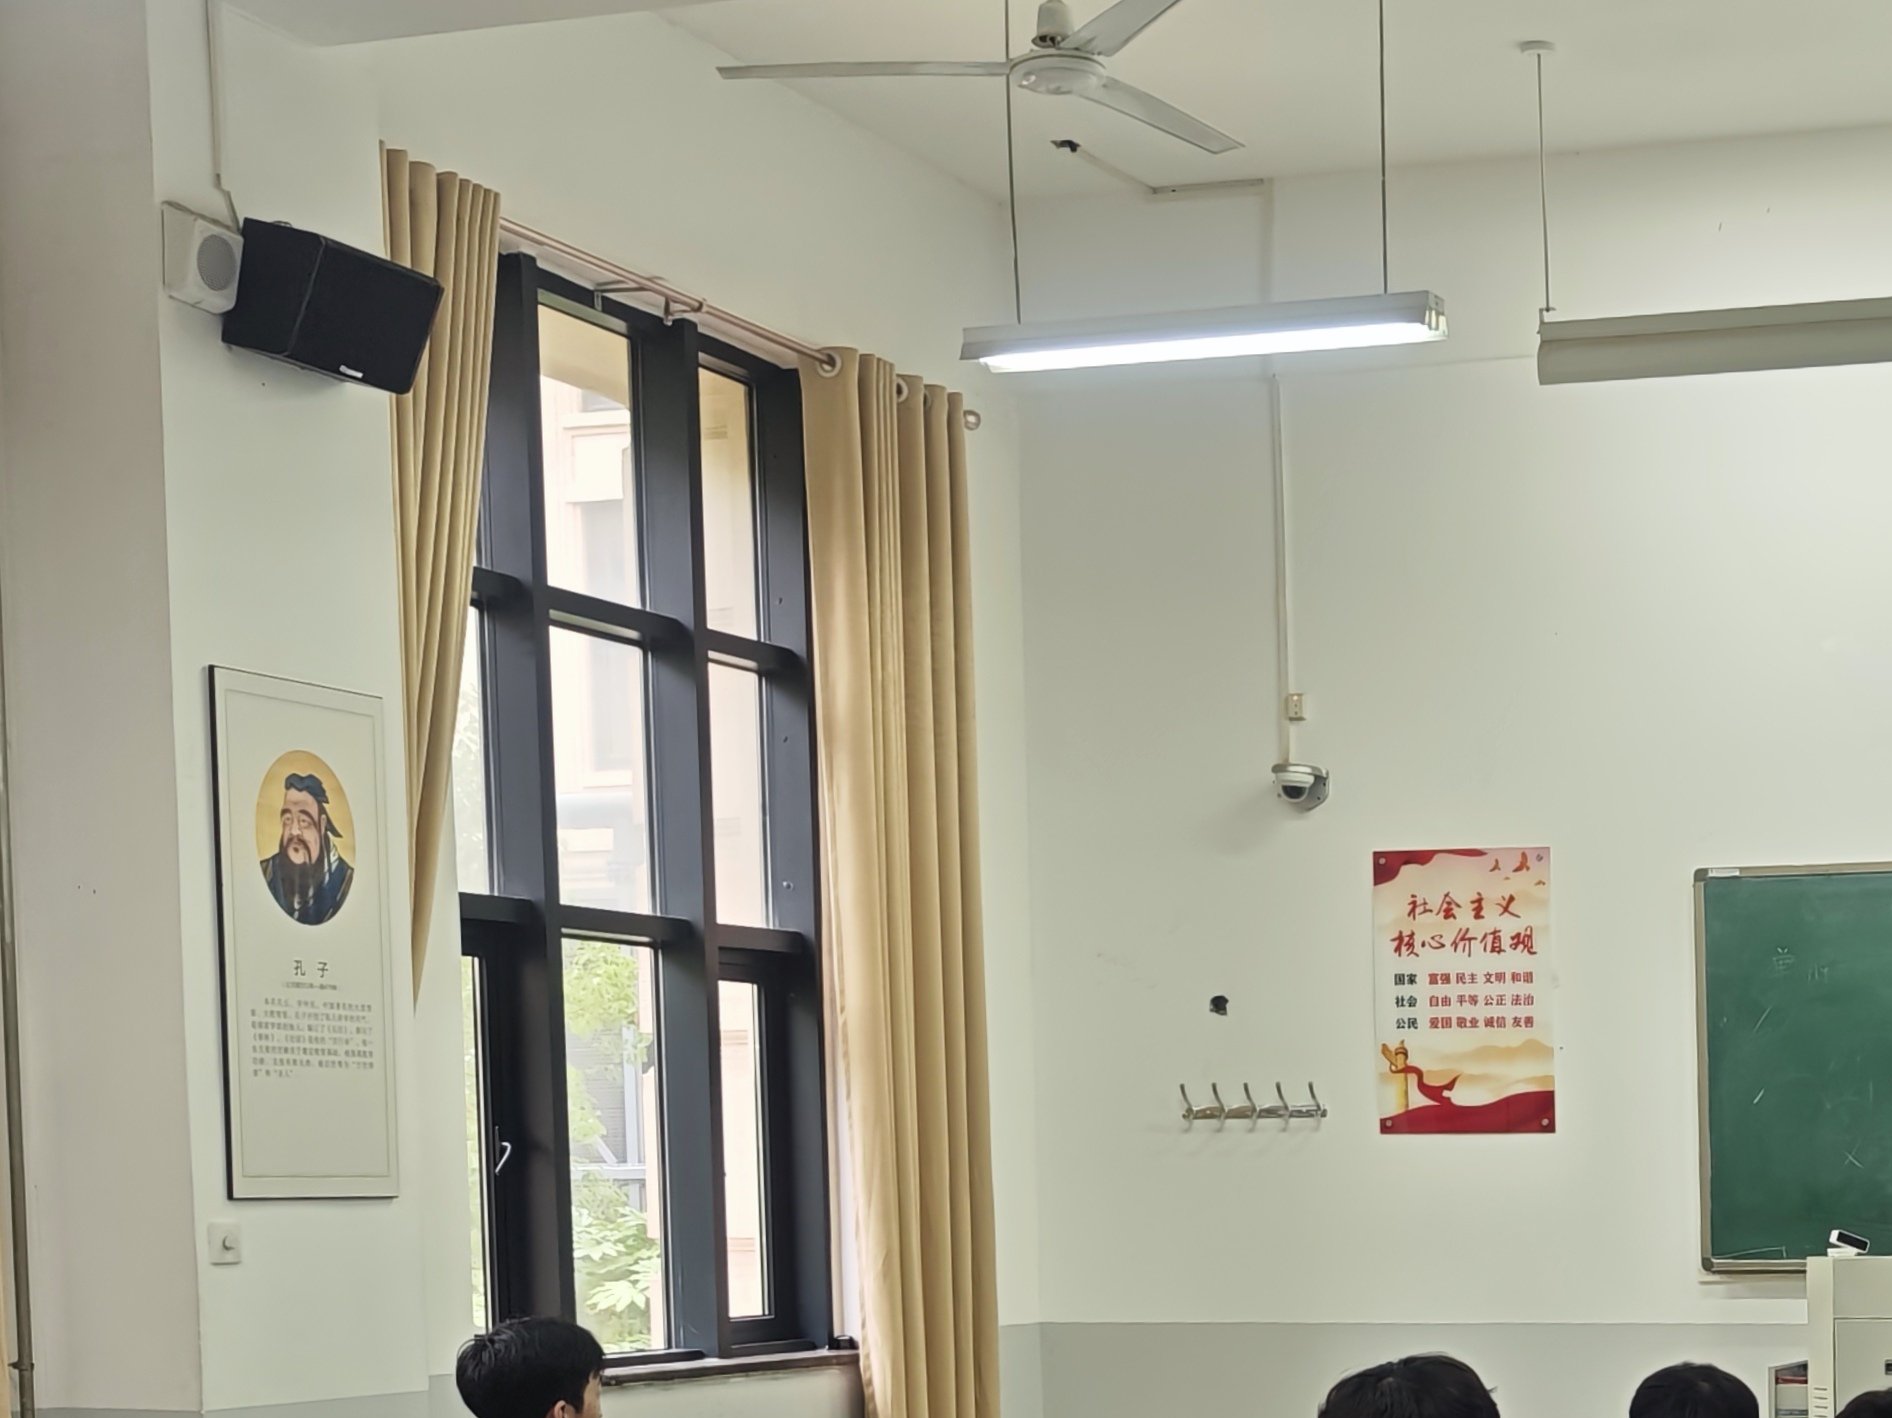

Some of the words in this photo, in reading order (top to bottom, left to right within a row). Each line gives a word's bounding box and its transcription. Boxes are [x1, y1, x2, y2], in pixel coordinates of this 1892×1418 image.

[1407, 891, 1522, 921] 社会主义
[1390, 925, 1538, 958] 核心价值观
[294, 959, 329, 978] 孔子
[1394, 973, 1418, 986] 国家
[1428, 972, 1451, 985] 富强
[1456, 972, 1478, 984] 民主
[1483, 971, 1506, 984] 文明
[1395, 995, 1418, 1008] 社会
[1429, 995, 1451, 1007] 自由
[1456, 994, 1479, 1007] 平等
[1484, 994, 1507, 1006] 公正
[1511, 993, 1534, 1006] 法治
[1396, 1017, 1418, 1030] 公民
[1429, 1016, 1453, 1029] 爱国
[1456, 1016, 1479, 1029] 敬业
[1483, 1016, 1506, 1029] 诚信
[1511, 1016, 1534, 1028] 友善
